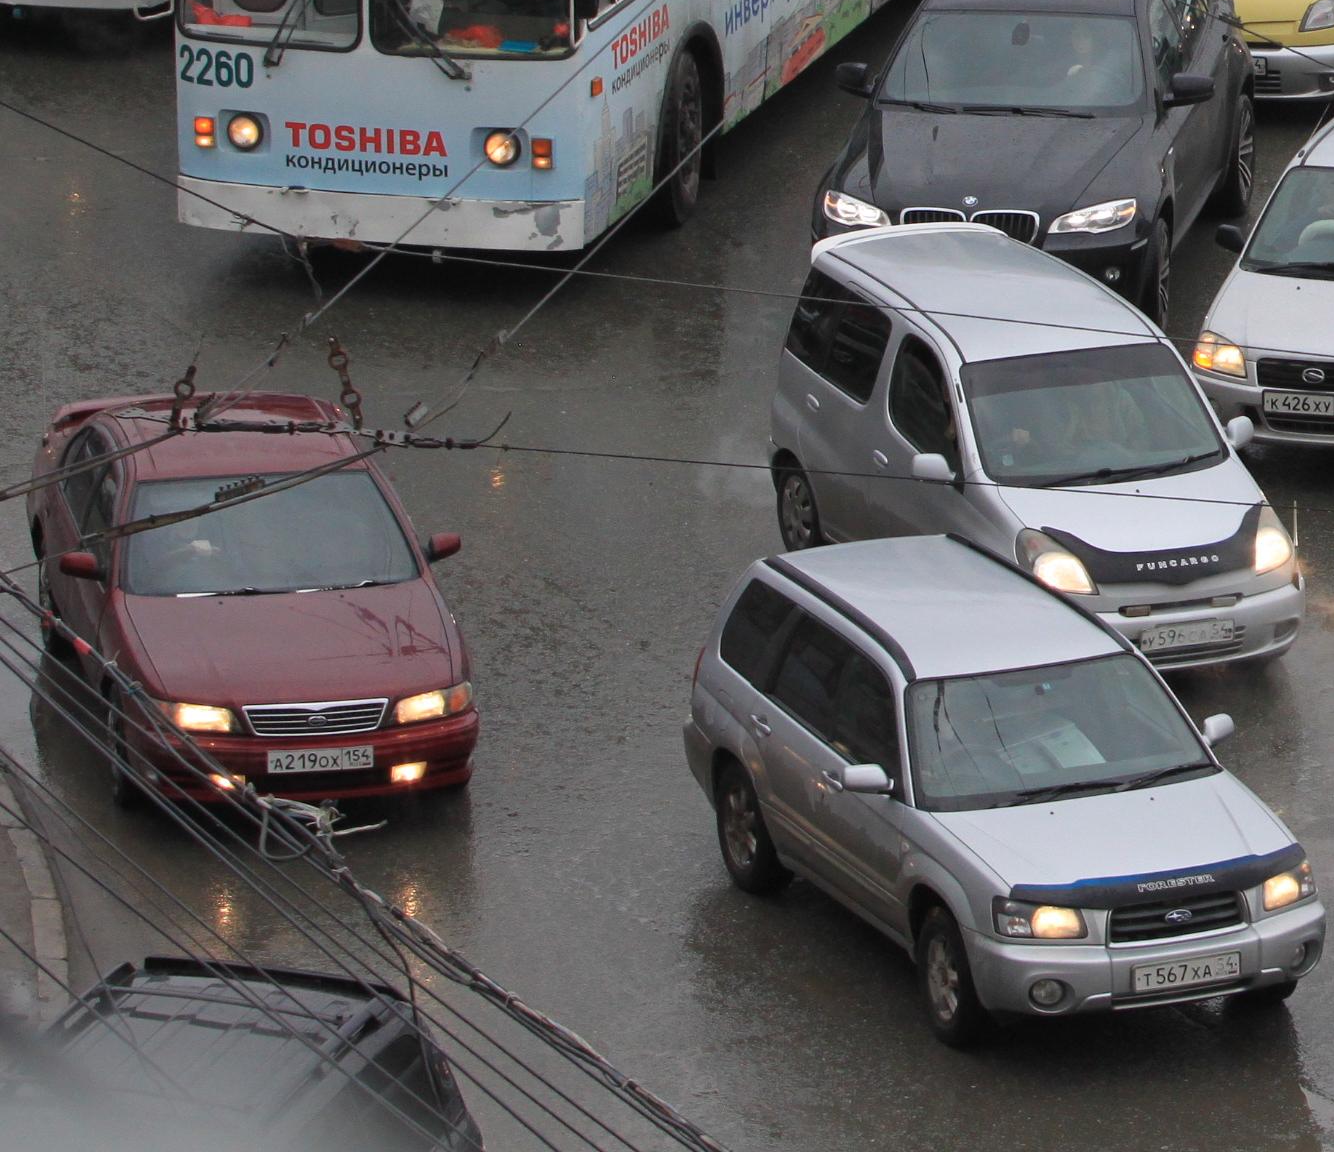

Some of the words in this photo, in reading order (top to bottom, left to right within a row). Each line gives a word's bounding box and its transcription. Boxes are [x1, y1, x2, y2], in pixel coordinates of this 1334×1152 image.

[611, 3, 670, 70] TOSHIBA
[179, 44, 255, 89] 2260
[610, 40, 671, 95] кондиционеры
[284, 120, 449, 158] TOSHIBA
[284, 152, 450, 181] кондиционеры
[1270, 396, 1331, 414] К426ХУ
[1136, 554, 1220, 572] FUNCARGO
[273, 753, 340, 771] А219ОХ
[344, 749, 370, 762] 154
[1137, 872, 1216, 894] FORESTER
[1145, 963, 1213, 987] Т567ХА
